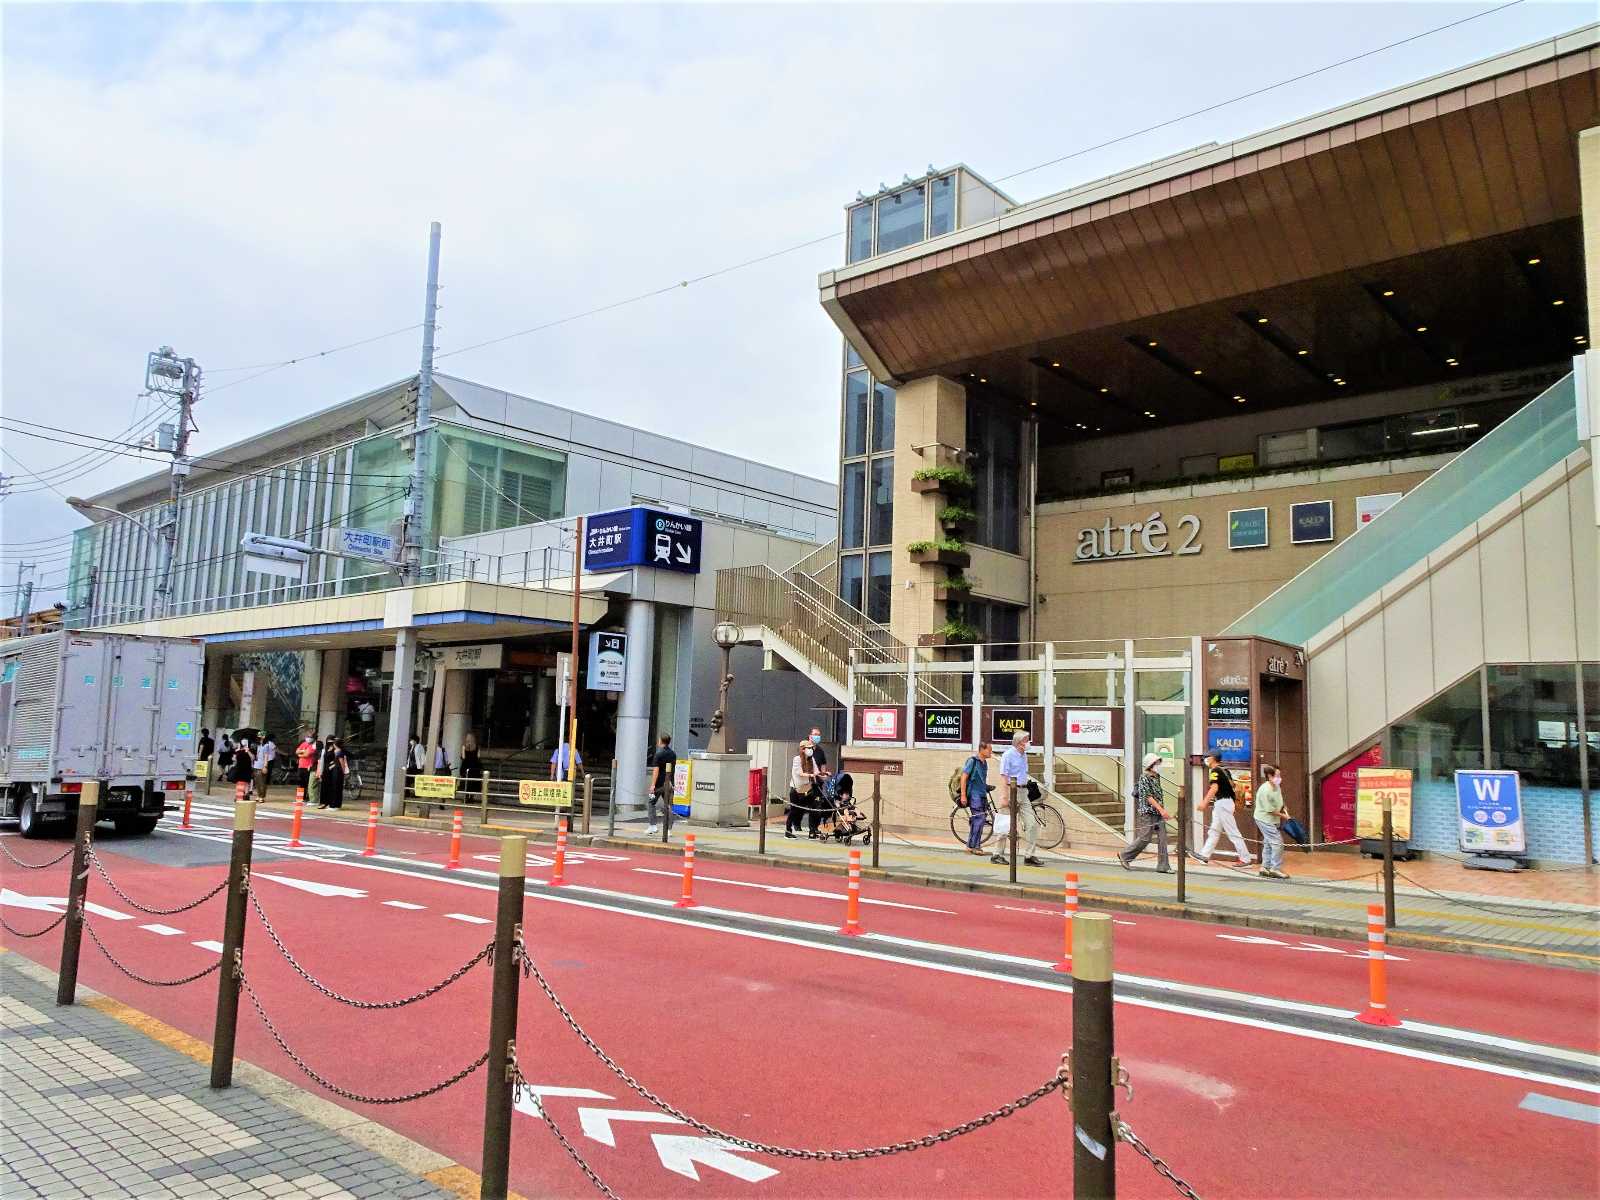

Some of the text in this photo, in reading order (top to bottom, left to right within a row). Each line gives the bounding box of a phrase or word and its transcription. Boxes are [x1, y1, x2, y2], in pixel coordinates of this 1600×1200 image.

[344, 531, 391, 549] 大井町駅前
[589, 533, 622, 548] 大井町駅
[1076, 511, 1202, 559] atré 2
[1220, 696, 1249, 706] SMBC
[936, 715, 960, 726] SMBC
[999, 719, 1025, 729] KALDI
[1216, 738, 1244, 748] KALDI
[1473, 778, 1501, 801] W
